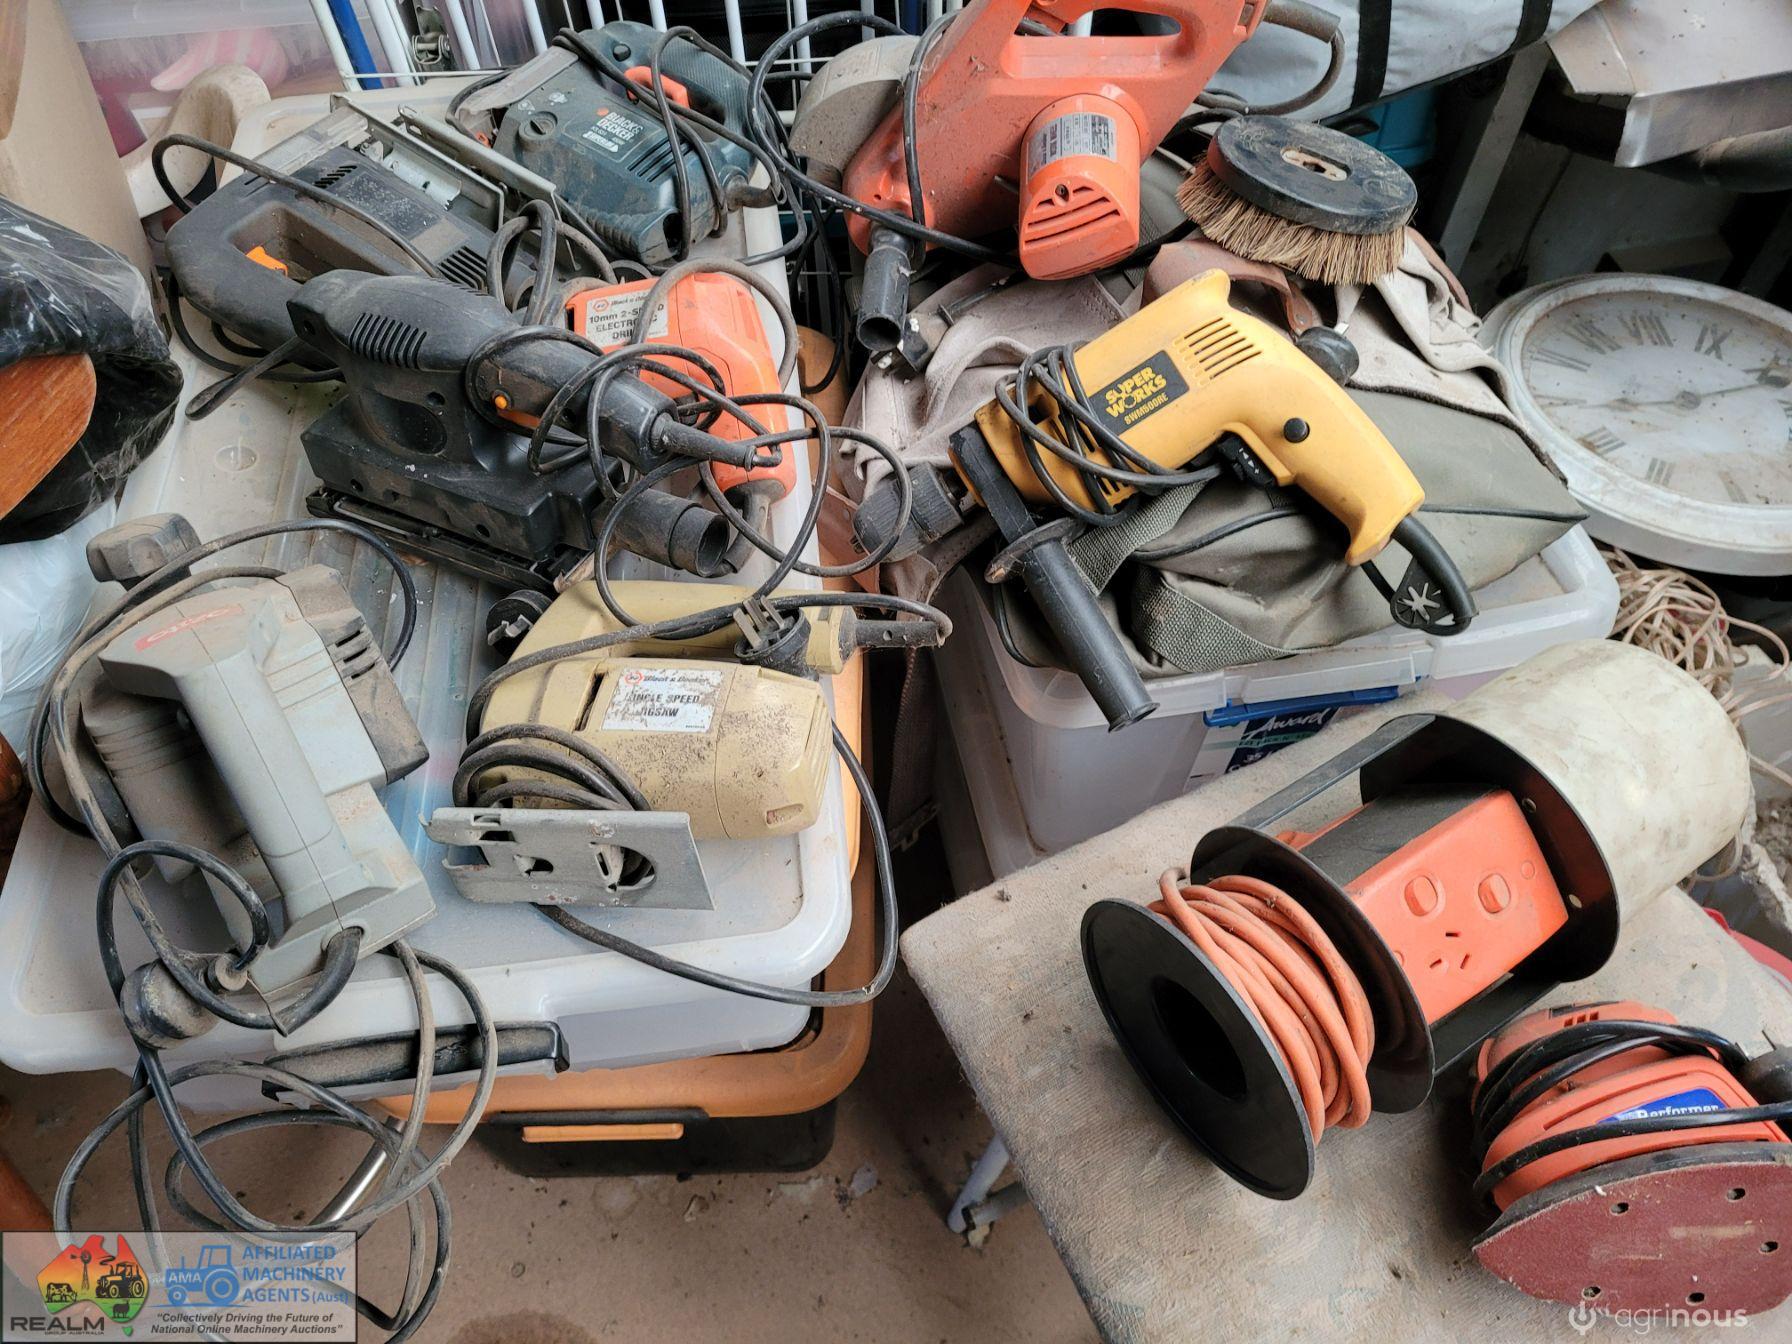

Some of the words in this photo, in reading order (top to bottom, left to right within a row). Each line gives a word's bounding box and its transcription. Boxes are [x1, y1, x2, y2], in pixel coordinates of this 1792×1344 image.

[597, 120, 634, 140] DECKER
[590, 314, 617, 323] 10mm
[621, 304, 664, 318] 2-SD
[1695, 322, 1733, 360] IX
[1105, 367, 1155, 404] SUPER
[1105, 374, 1167, 418] WORKS
[1123, 391, 1169, 425] SWM500RE
[666, 694, 700, 703] SPEED
[1240, 707, 1332, 742] Award
